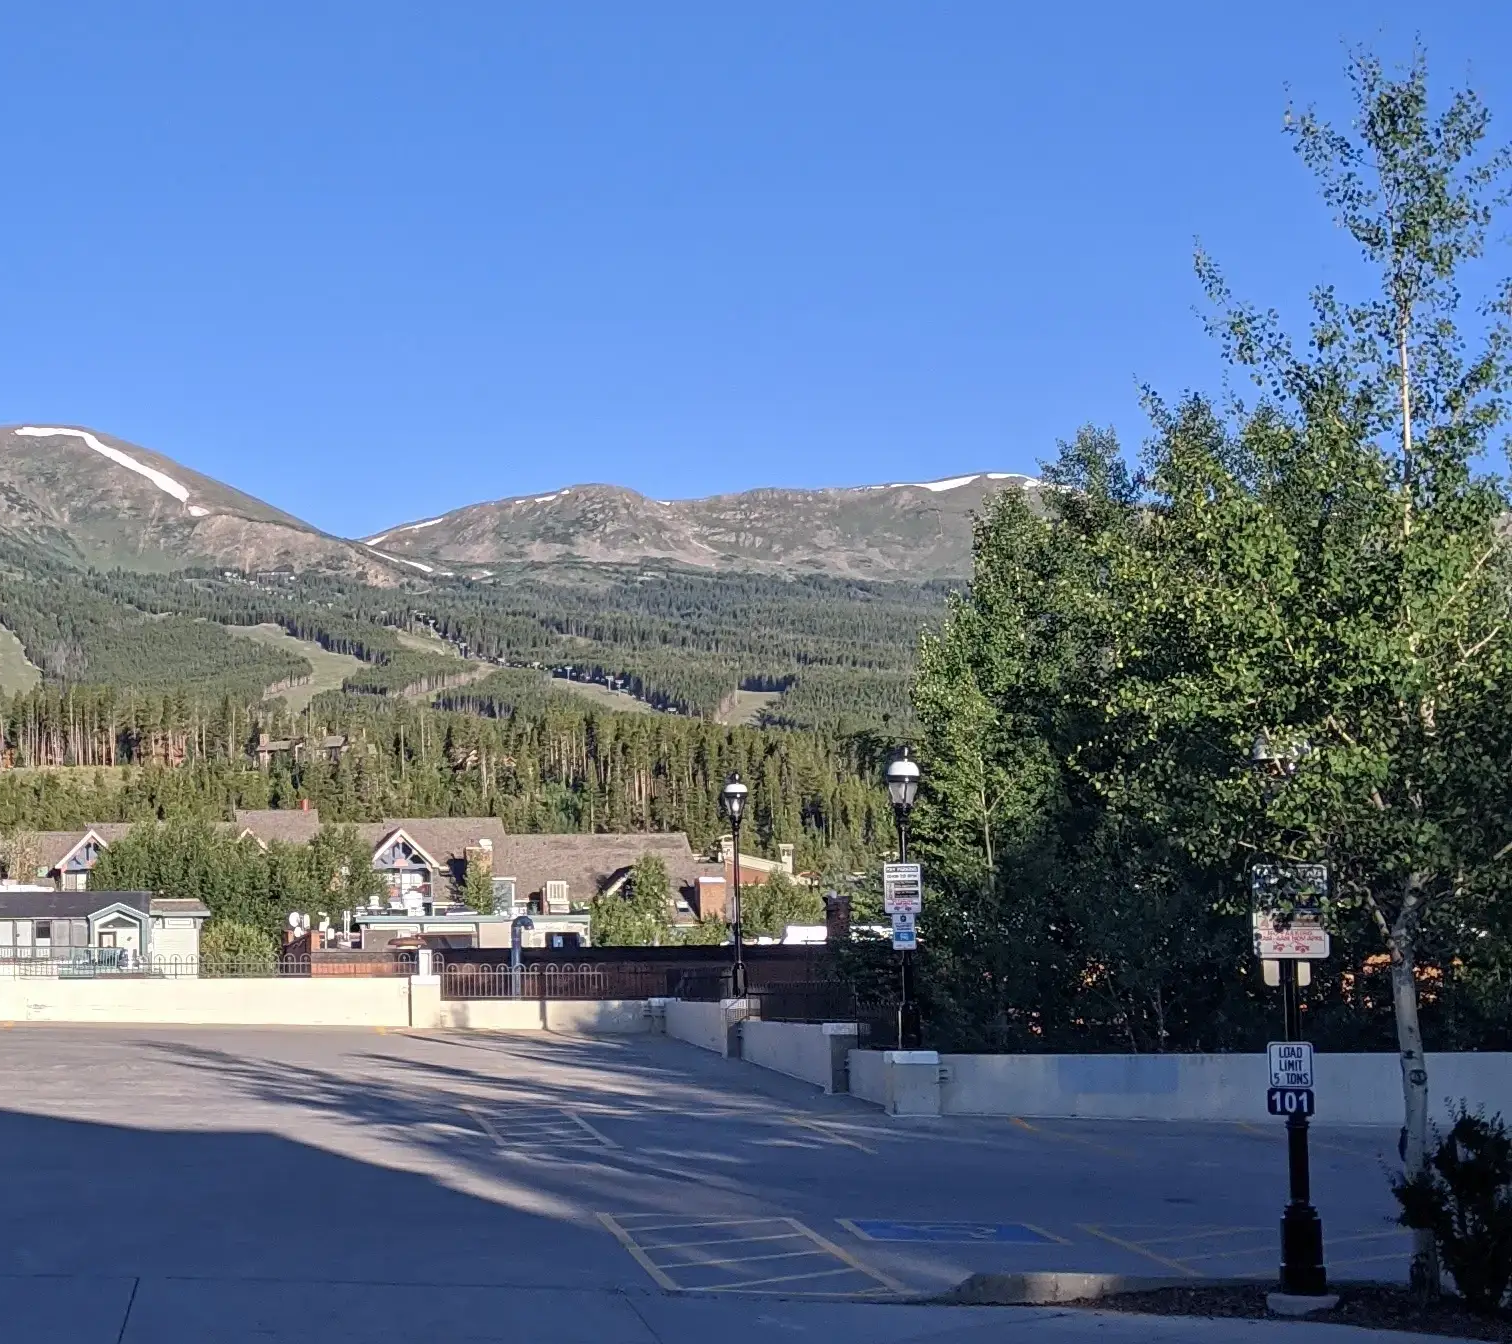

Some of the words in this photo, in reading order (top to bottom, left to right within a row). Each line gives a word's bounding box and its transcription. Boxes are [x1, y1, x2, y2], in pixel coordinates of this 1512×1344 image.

[1279, 1046, 1303, 1058] LOAD
[1279, 1060, 1303, 1072] LIMIT
[1273, 1073, 1280, 1085] 5
[1285, 1073, 1309, 1085] TONS
[1271, 1091, 1308, 1113] 101
